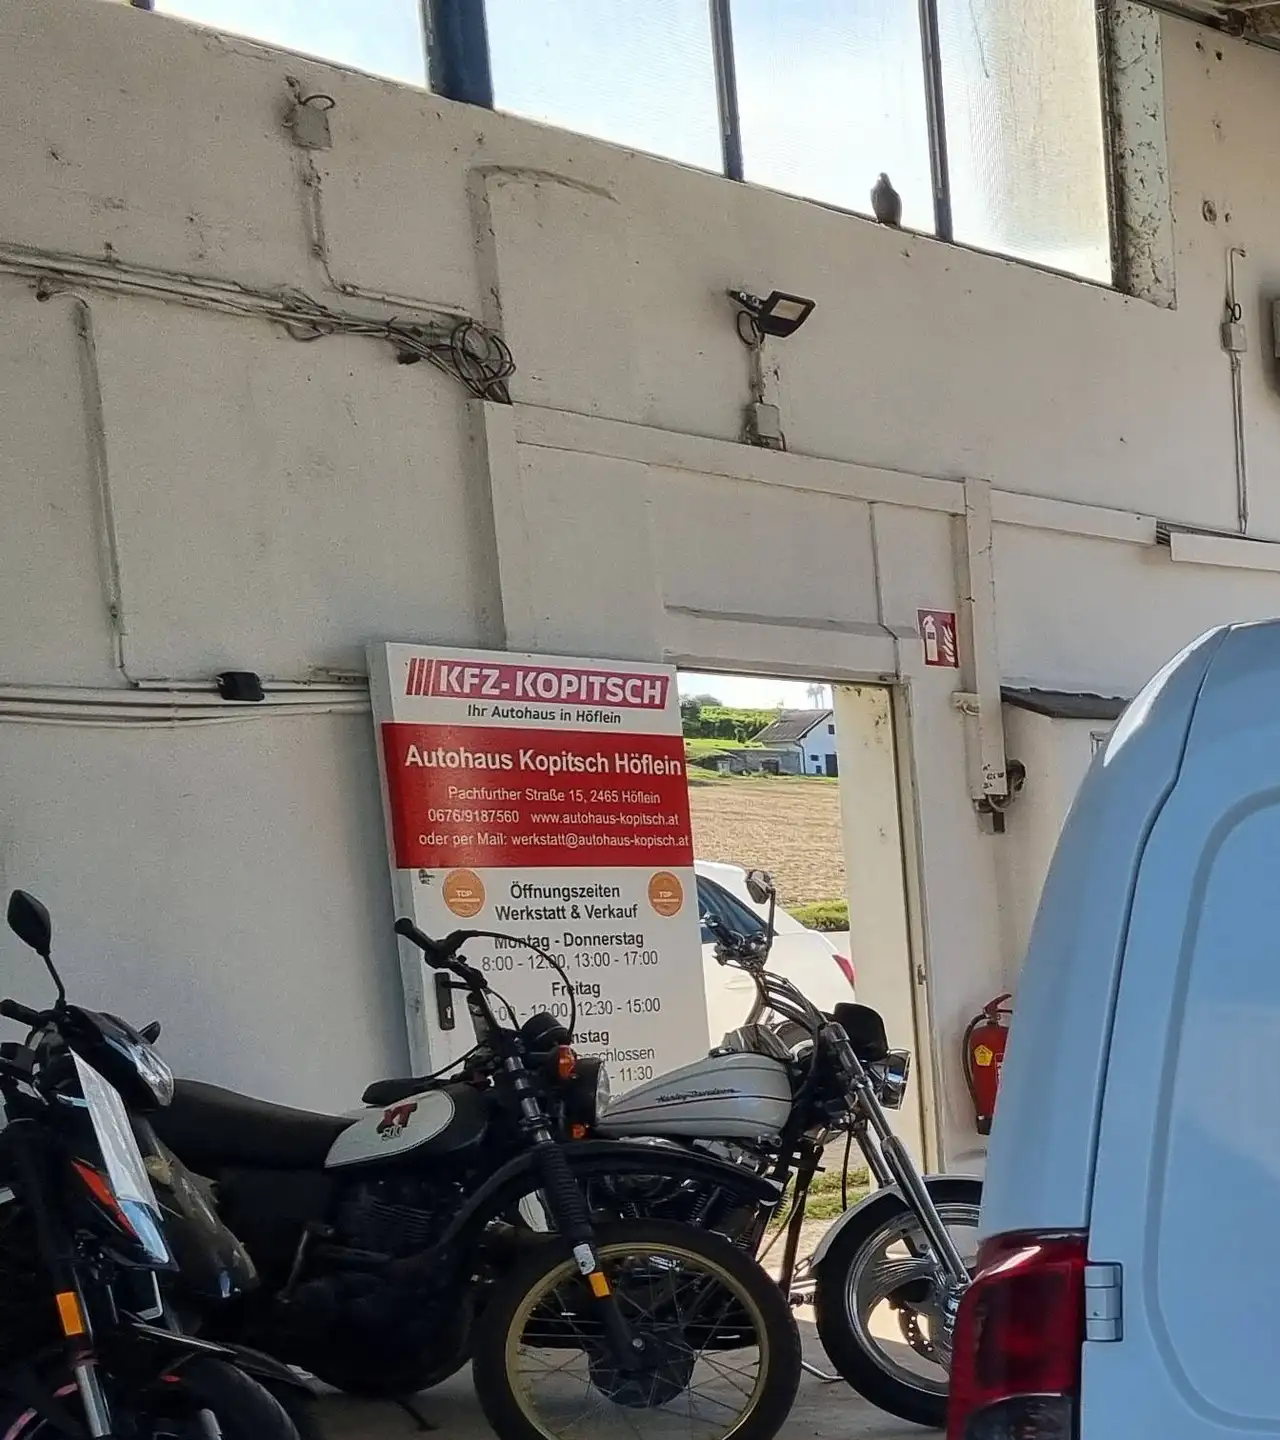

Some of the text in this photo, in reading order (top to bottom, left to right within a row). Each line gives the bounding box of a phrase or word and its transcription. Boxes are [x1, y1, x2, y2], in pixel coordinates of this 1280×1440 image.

[468, 704, 621, 725] Ihr Autohaus in Höflein
[405, 745, 682, 776] Autohaus Kopitsch Höflein
[448, 786, 661, 804] Pachfurther Straße 15, 2465 Höflein
[428, 808, 679, 827] 0676/9187560 www.autohaus-kopitsch.at
[419, 832, 689, 849] oder per Mail: werkstatt@autohaus-kopisch.at
[510, 881, 620, 903] Öffnungszeiten
[495, 903, 638, 921] Werkstatt & Verkauf
[494, 933, 549, 951] Montag
[564, 932, 644, 949] Donnerstag
[481, 955, 513, 972] 8:00
[576, 951, 611, 968] 13:00
[624, 950, 659, 966] 17:00
[577, 1000, 613, 1016] 12:30
[627, 997, 661, 1014] 15:00
[620, 1065, 653, 1082] 11:30
